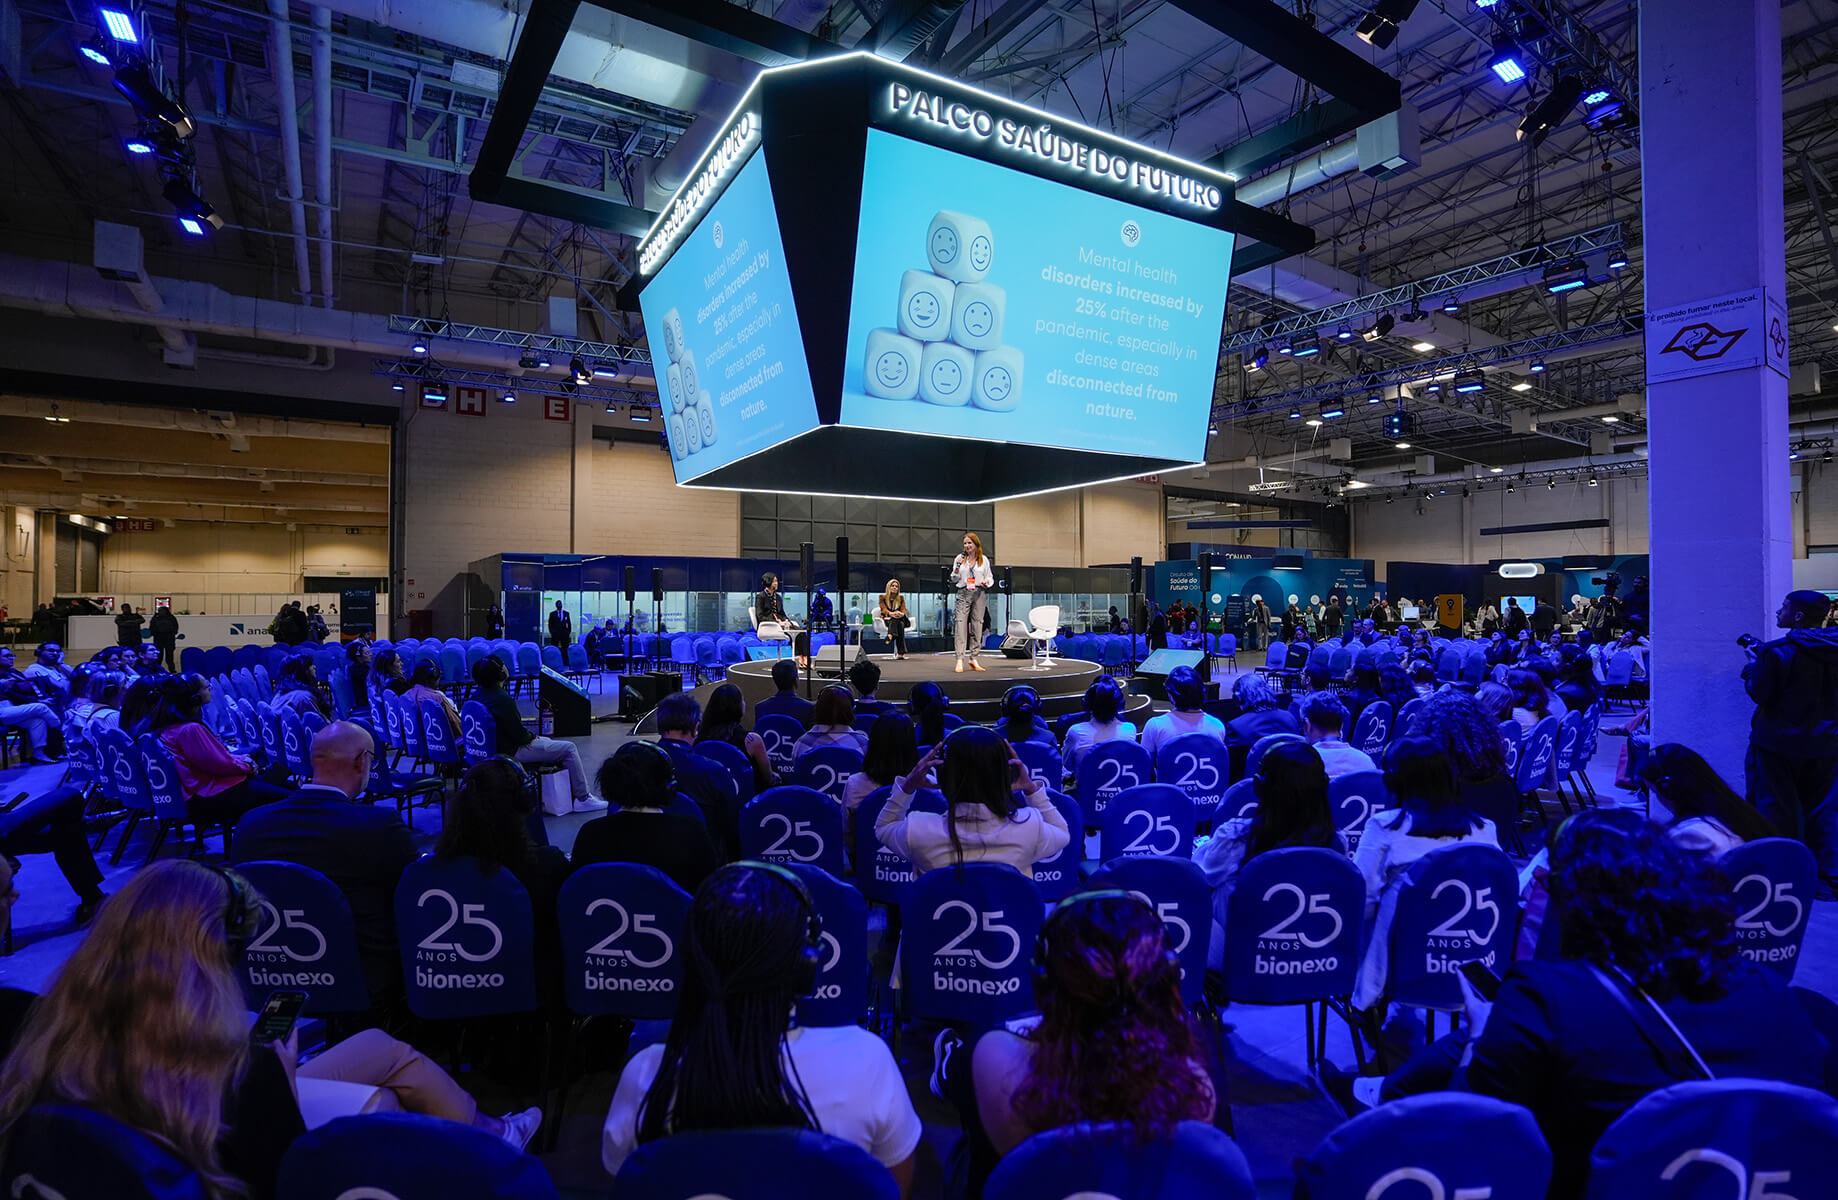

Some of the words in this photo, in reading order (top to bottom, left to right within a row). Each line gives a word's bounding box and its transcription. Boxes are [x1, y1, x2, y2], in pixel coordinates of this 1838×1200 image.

[892, 82, 995, 138] PALCO
[1000, 118, 1089, 169] SAÚDE
[1093, 148, 1130, 181] DO
[1135, 161, 1223, 210] FUTURO
[1079, 246, 1130, 273] Mental
[1134, 260, 1177, 285] health
[697, 292, 725, 323] disorders
[724, 255, 759, 299] increased
[758, 249, 769, 269] by
[1041, 265, 1113, 295] disorders
[1116, 281, 1184, 310] increased
[1187, 297, 1204, 318] by
[714, 313, 728, 335] 25%
[744, 291, 758, 310] the
[773, 302, 781, 318] in
[1075, 297, 1107, 318] 25%
[1110, 306, 1144, 325] after
[1148, 313, 1169, 332] the
[1657, 309, 1687, 321] proibido
[1688, 305, 1711, 314] fumar
[1713, 300, 1735, 309] neste
[745, 343, 766, 366] areas
[1118, 335, 1183, 360] especially
[1186, 344, 1198, 360] in
[1074, 348, 1118, 370] dense
[1121, 359, 1159, 377] areas
[720, 369, 763, 407] disconnected
[763, 360, 784, 382] from
[1046, 368, 1143, 397] disconnected
[1146, 384, 1178, 402] from
[460, 390, 483, 413] H
[550, 399, 566, 418] E
[741, 399, 768, 420] nature.
[1086, 402, 1137, 421] nature.
[400, 707, 414, 735] 25
[423, 712, 443, 741] 25
[464, 714, 486, 746] 25
[1365, 716, 1386, 743] 25
[763, 729, 795, 762] 25
[1534, 733, 1553, 763] 25
[108, 745, 132, 781] 25
[1096, 758, 1140, 792] 25
[1174, 752, 1219, 790] 25
[1192, 794, 1220, 805] nexo
[759, 813, 824, 862] 25
[1122, 810, 1181, 856] 25
[875, 866, 914, 883] bion
[1258, 882, 1343, 949] 25
[1426, 879, 1500, 946] 25
[1732, 874, 1803, 937] 25
[246, 900, 327, 962] 25
[416, 888, 503, 962] 25
[584, 898, 674, 968] 25
[932, 900, 1021, 970] 25
[1736, 930, 1767, 939] NOS
[247, 952, 287, 963] ANOS
[416, 951, 457, 962] ANOS
[1257, 941, 1300, 950] ANOS
[1426, 938, 1472, 949] ANOS
[1737, 944, 1797, 962] onexo
[584, 956, 629, 968] ANOS
[933, 957, 977, 967] ANOS
[1254, 954, 1338, 976] bionexo
[249, 967, 335, 987] bionexo
[416, 965, 504, 989] bionexo
[584, 970, 675, 992] bionexo
[933, 971, 1021, 996] bionexo
